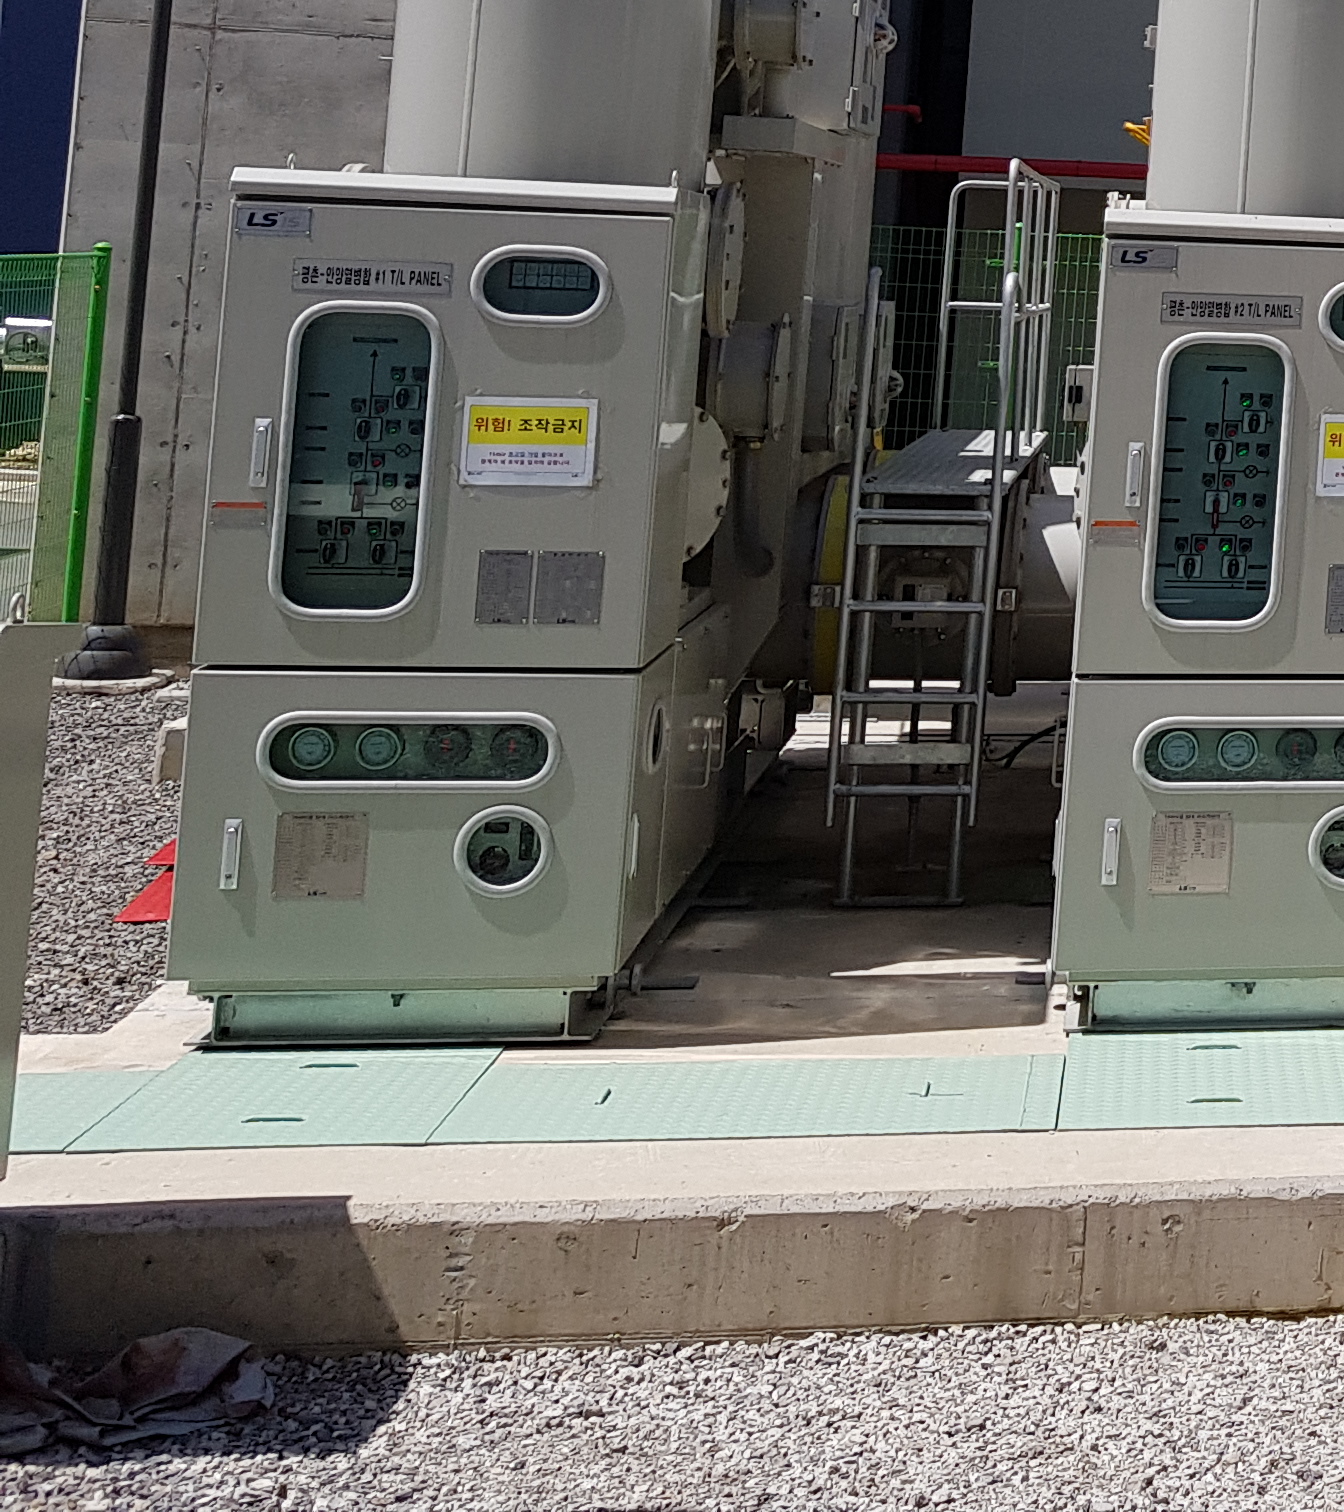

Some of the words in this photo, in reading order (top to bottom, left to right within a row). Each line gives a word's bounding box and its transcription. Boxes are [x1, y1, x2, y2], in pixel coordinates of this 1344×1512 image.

[375, 269, 386, 285] #1
[390, 269, 405, 286] T/L
[408, 270, 442, 287] PANEL
[1234, 304, 1245, 317] #2
[1247, 302, 1261, 318] T/L
[1264, 303, 1294, 319] PANEL
[474, 416, 511, 433] 위험!
[518, 418, 582, 434] 조작금지
